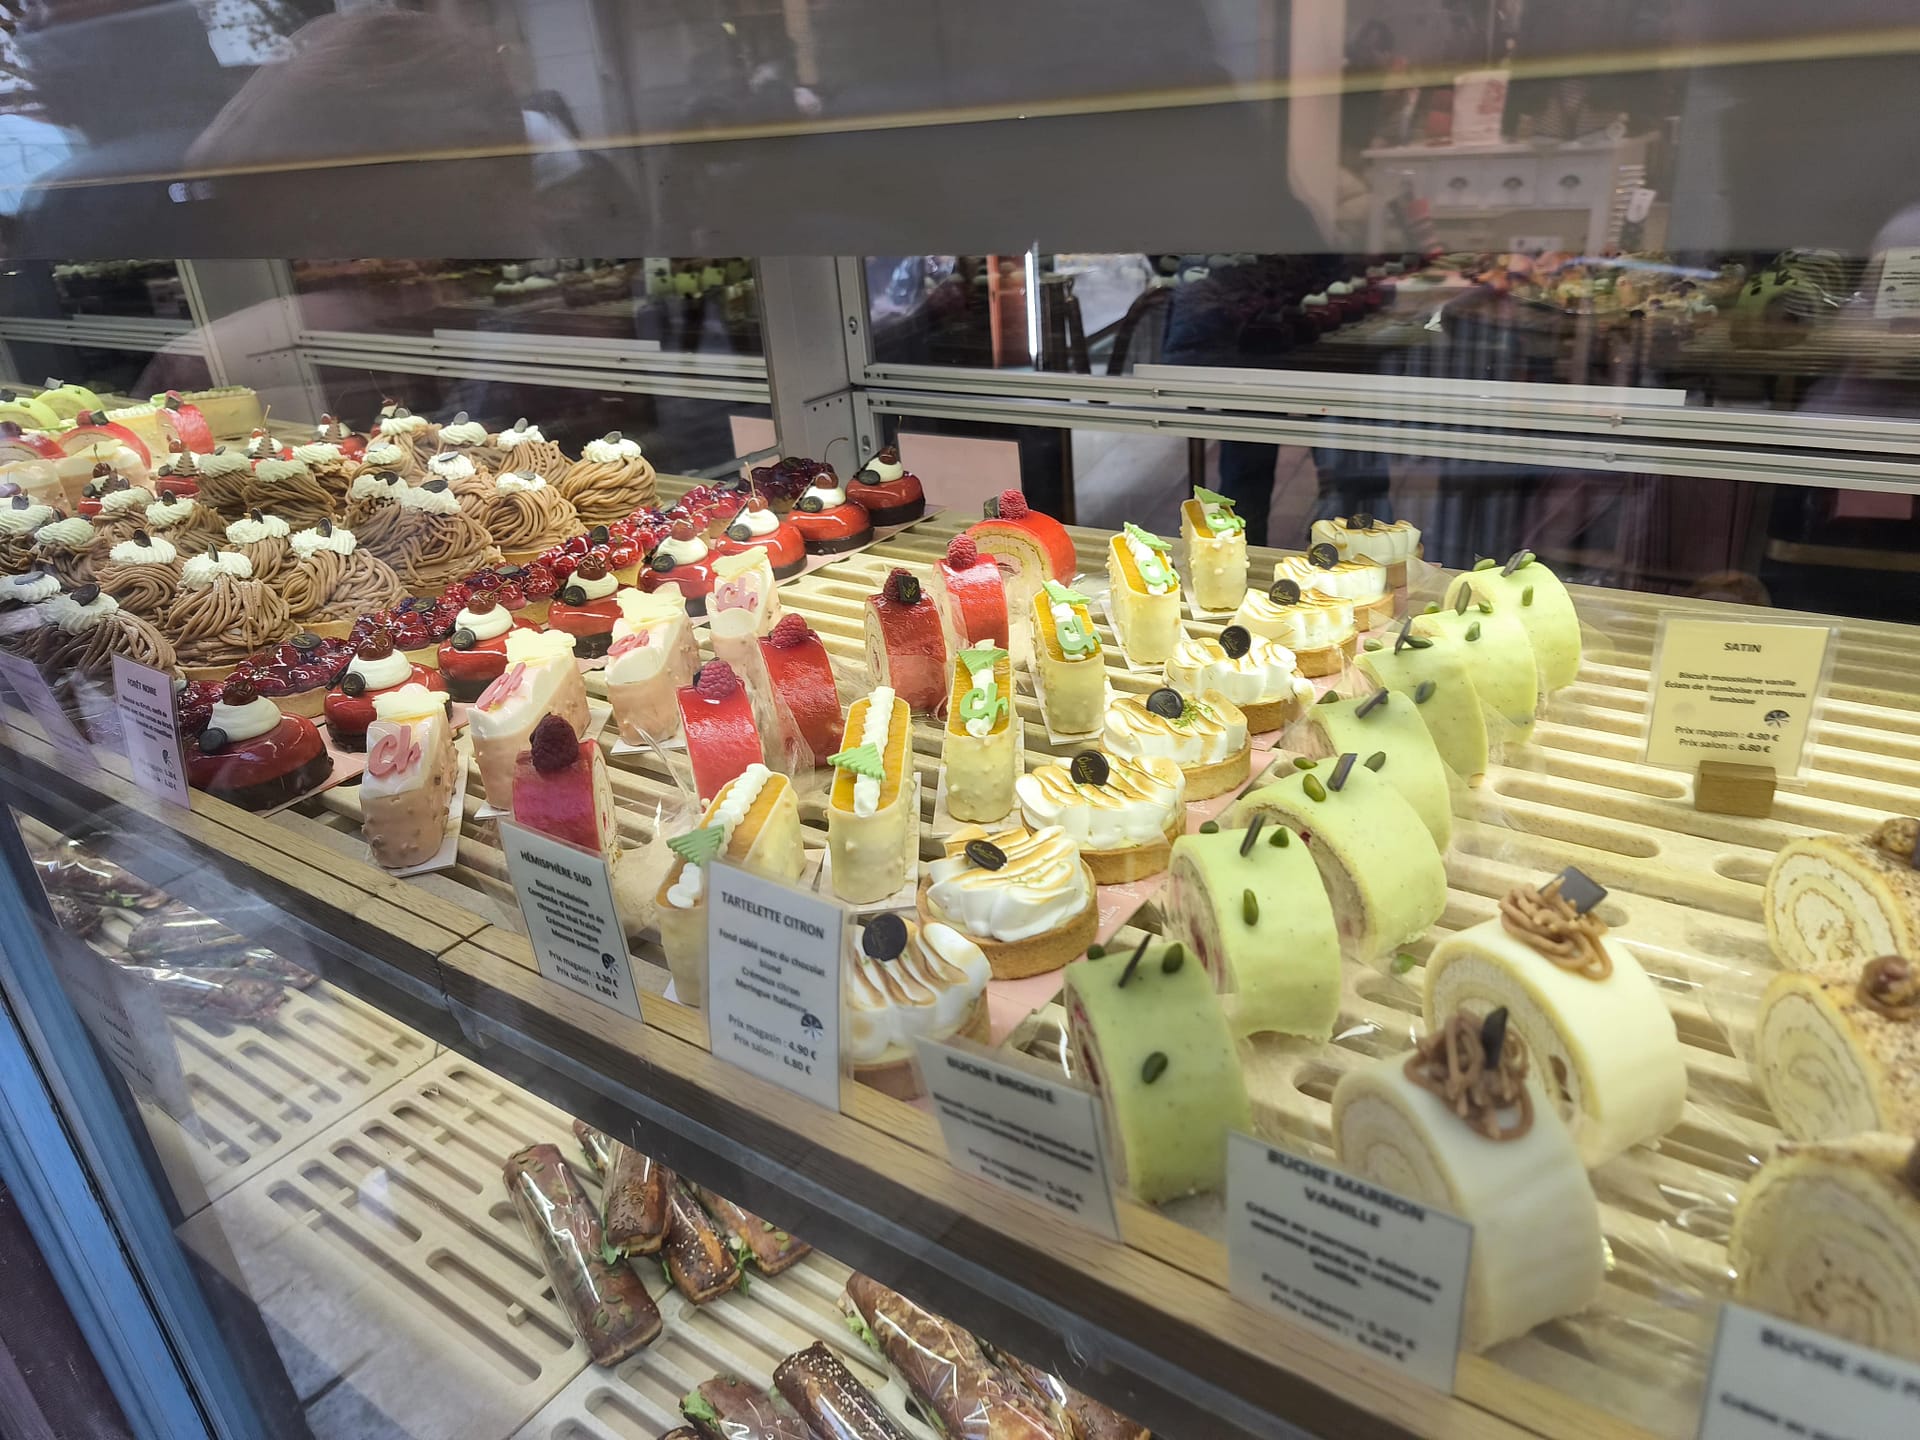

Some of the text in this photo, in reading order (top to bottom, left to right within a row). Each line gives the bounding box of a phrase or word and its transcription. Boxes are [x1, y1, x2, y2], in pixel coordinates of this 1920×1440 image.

[1724, 642, 1762, 653] SATIN
[1678, 671, 1797, 687] Biscuit mousseline vanille
[1706, 685, 1753, 695] framboise
[1754, 688, 1764, 696] et
[1709, 695, 1756, 705] framboise
[1674, 726, 1694, 735] Prix
[1696, 728, 1738, 739] magasin
[1746, 732, 1770, 741] 4.90
[1771, 734, 1780, 742] €
[1679, 738, 1698, 747] Prix
[1700, 740, 1728, 750] salon
[1738, 743, 1761, 752] 6.80
[1763, 745, 1771, 753] €
[520, 850, 592, 887] HÉMISPHÈRE SUD
[721, 891, 824, 940] TARTELETTE CITRON
[719, 928, 825, 977] Fond sablé avec du chocolat
[759, 958, 782, 975] blond
[548, 950, 562, 963] Prix
[563, 957, 592, 976] magasin
[596, 971, 612, 984] 5.30
[556, 965, 569, 977] Prix
[570, 972, 589, 986] salon
[735, 978, 771, 1001] Meringue
[741, 966, 801, 997] Crémeux citron
[728, 1014, 744, 1030] Prix
[746, 1022, 781, 1047] magasin
[788, 1041, 809, 1058] 4.90
[810, 1050, 817, 1062] €
[733, 1033, 750, 1049] Prix
[751, 1040, 775, 1061] salon
[783, 1055, 804, 1071] 6.80
[947, 1056, 992, 1081] BUCHE
[1267, 1149, 1425, 1223] BUCHE MARRON
[1304, 1186, 1381, 1229] VANILLE
[1760, 1328, 1846, 1374] BUCHE
[1855, 1364, 1897, 1391] AU
